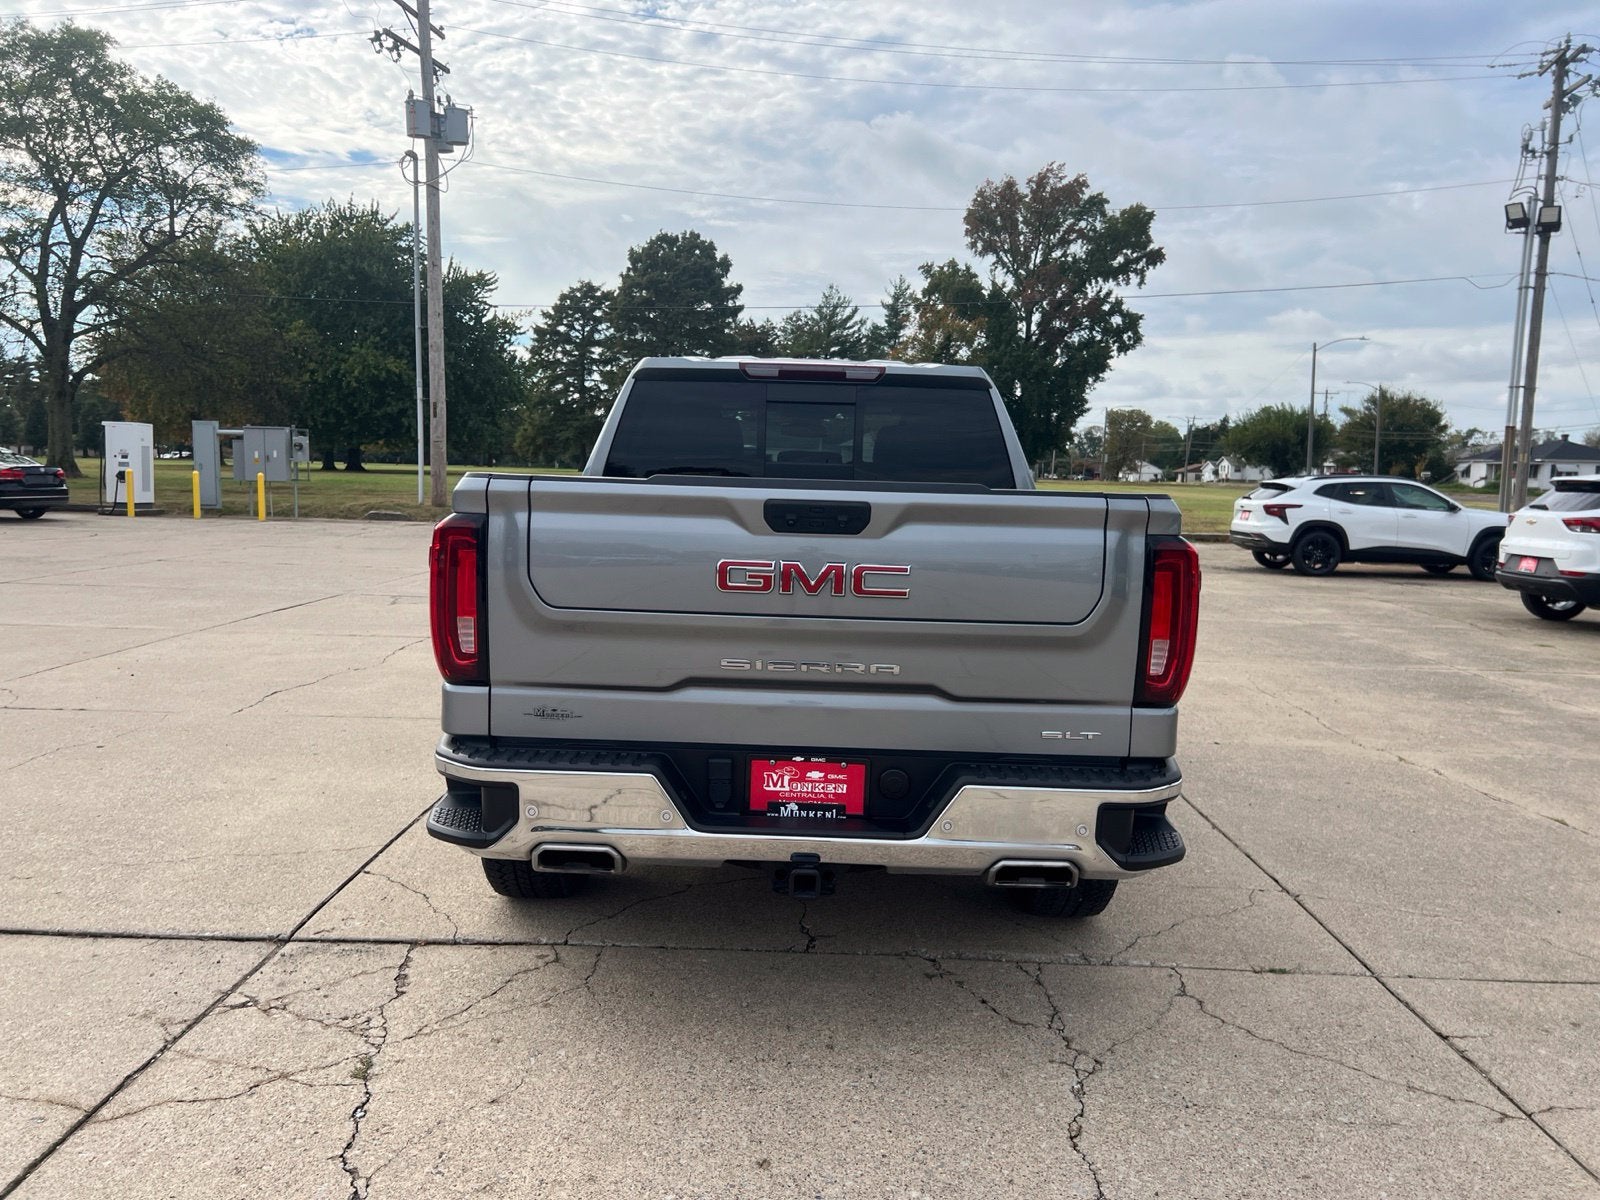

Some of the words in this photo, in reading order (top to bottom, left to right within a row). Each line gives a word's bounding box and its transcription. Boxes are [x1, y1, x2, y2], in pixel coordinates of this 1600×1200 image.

[716, 558, 911, 599] GMC
[720, 657, 901, 676] SIERRA
[1041, 730, 1102, 741] SLT
[763, 771, 847, 793] MONKEN
